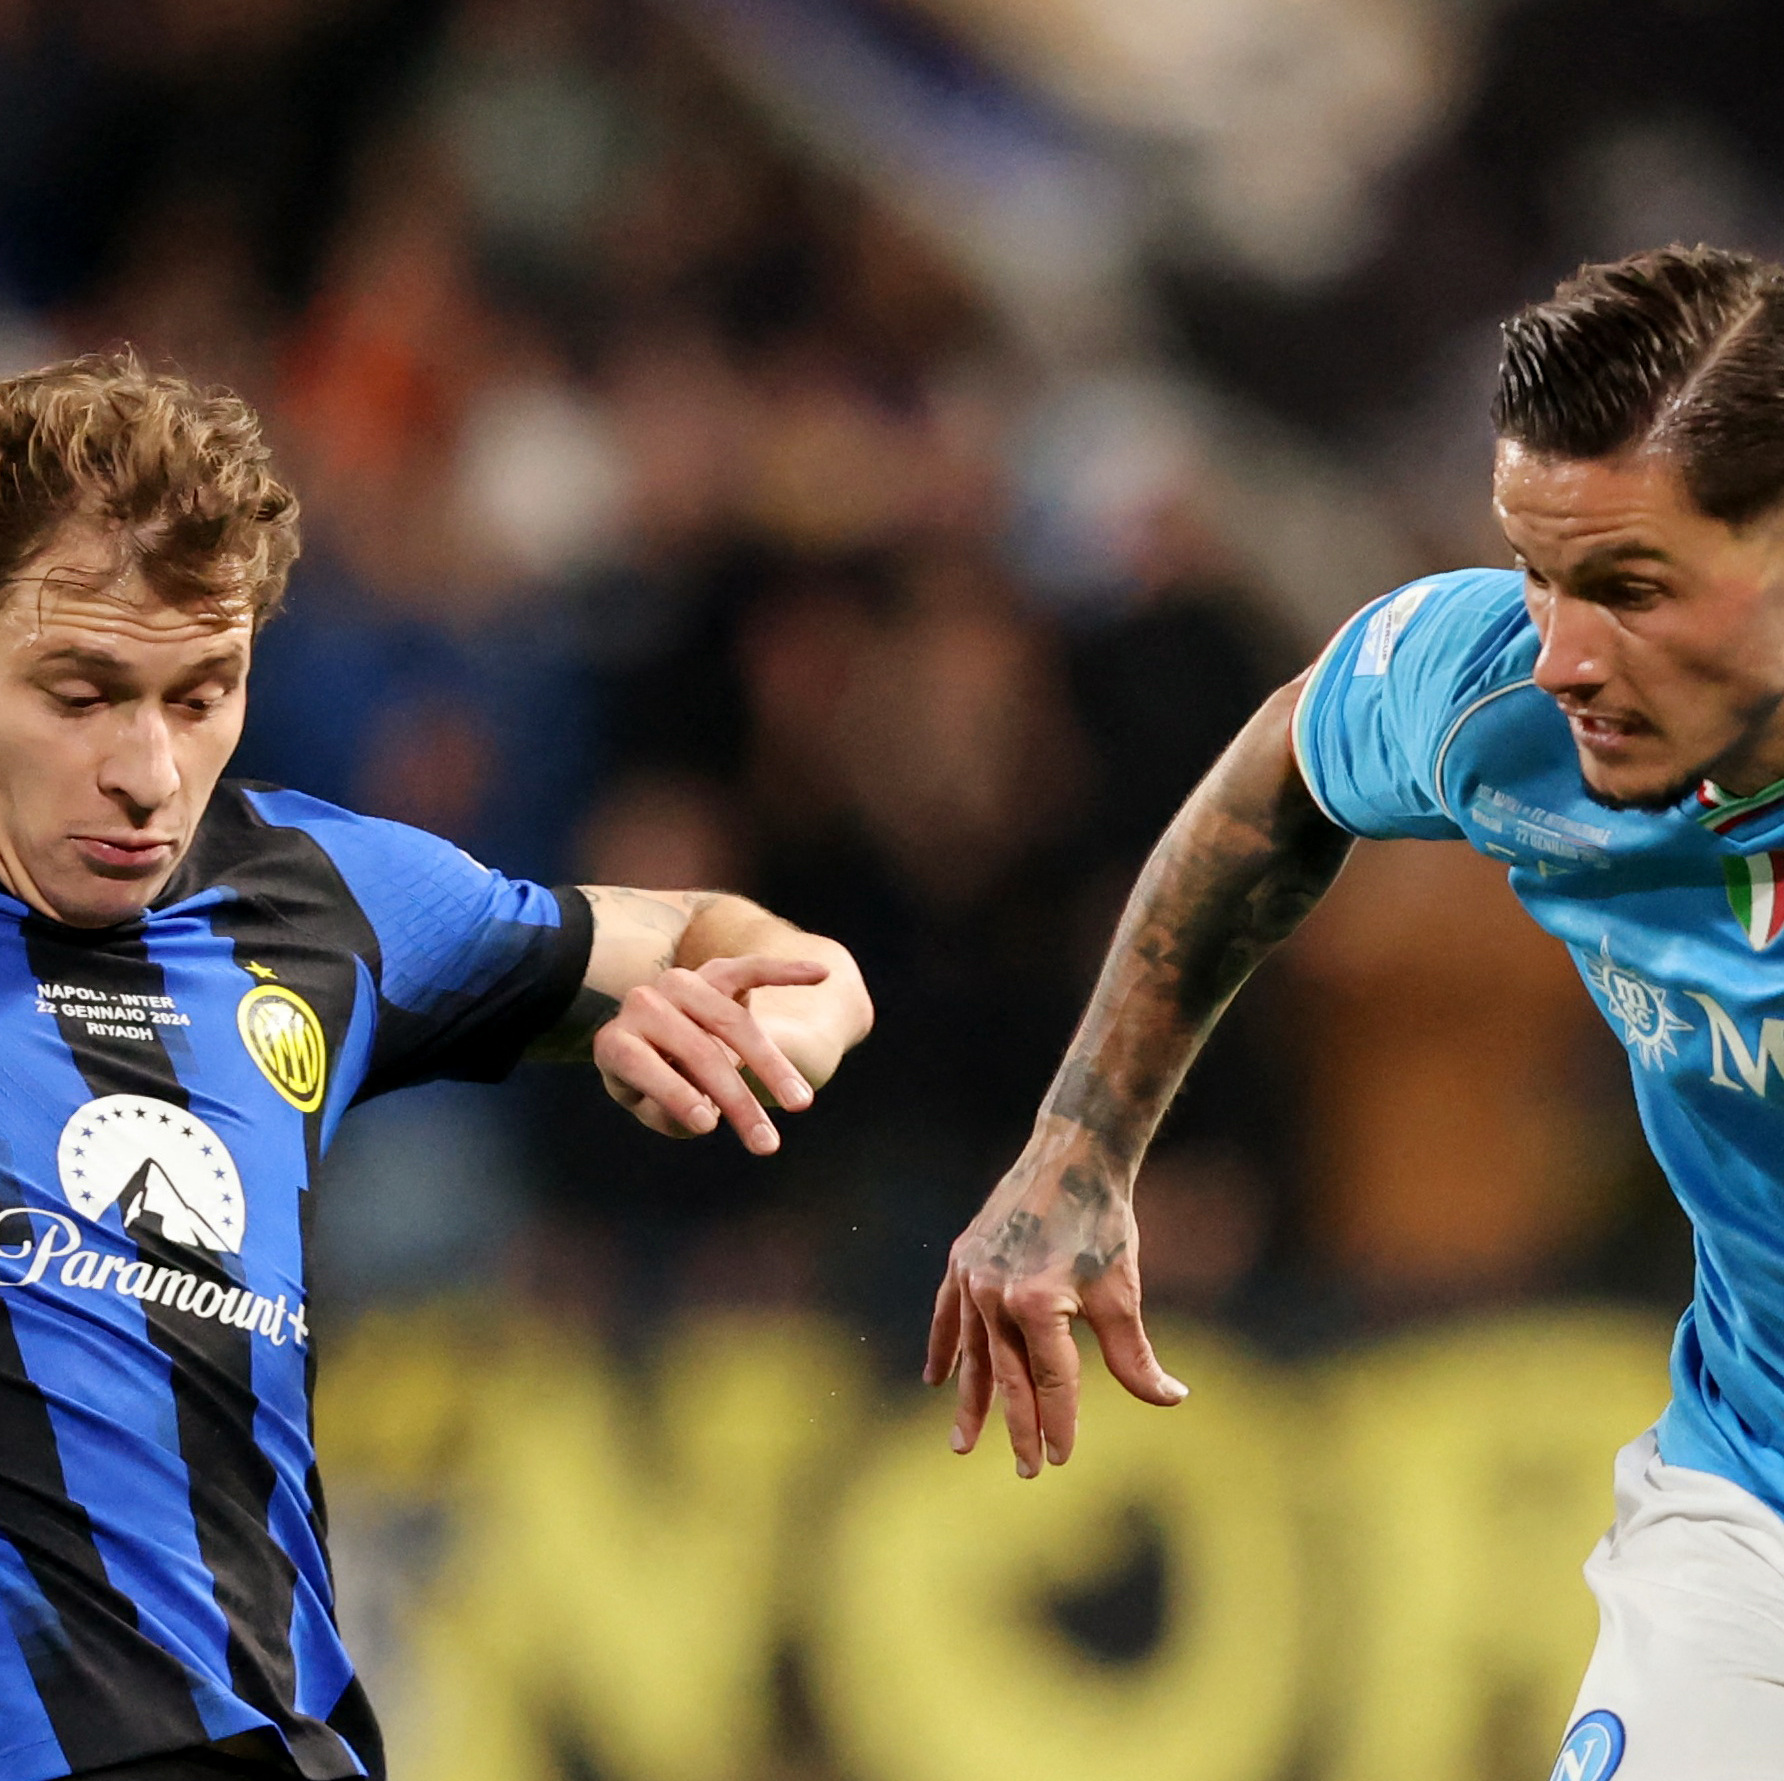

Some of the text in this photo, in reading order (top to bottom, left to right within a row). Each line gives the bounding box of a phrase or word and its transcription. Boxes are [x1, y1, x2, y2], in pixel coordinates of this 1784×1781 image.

[36, 983, 108, 1002] NAPOLI
[119, 993, 177, 1010] INTER
[34, 1000, 192, 1027] 22 GENNAIO 2024
[85, 1021, 155, 1042] RIYADH
